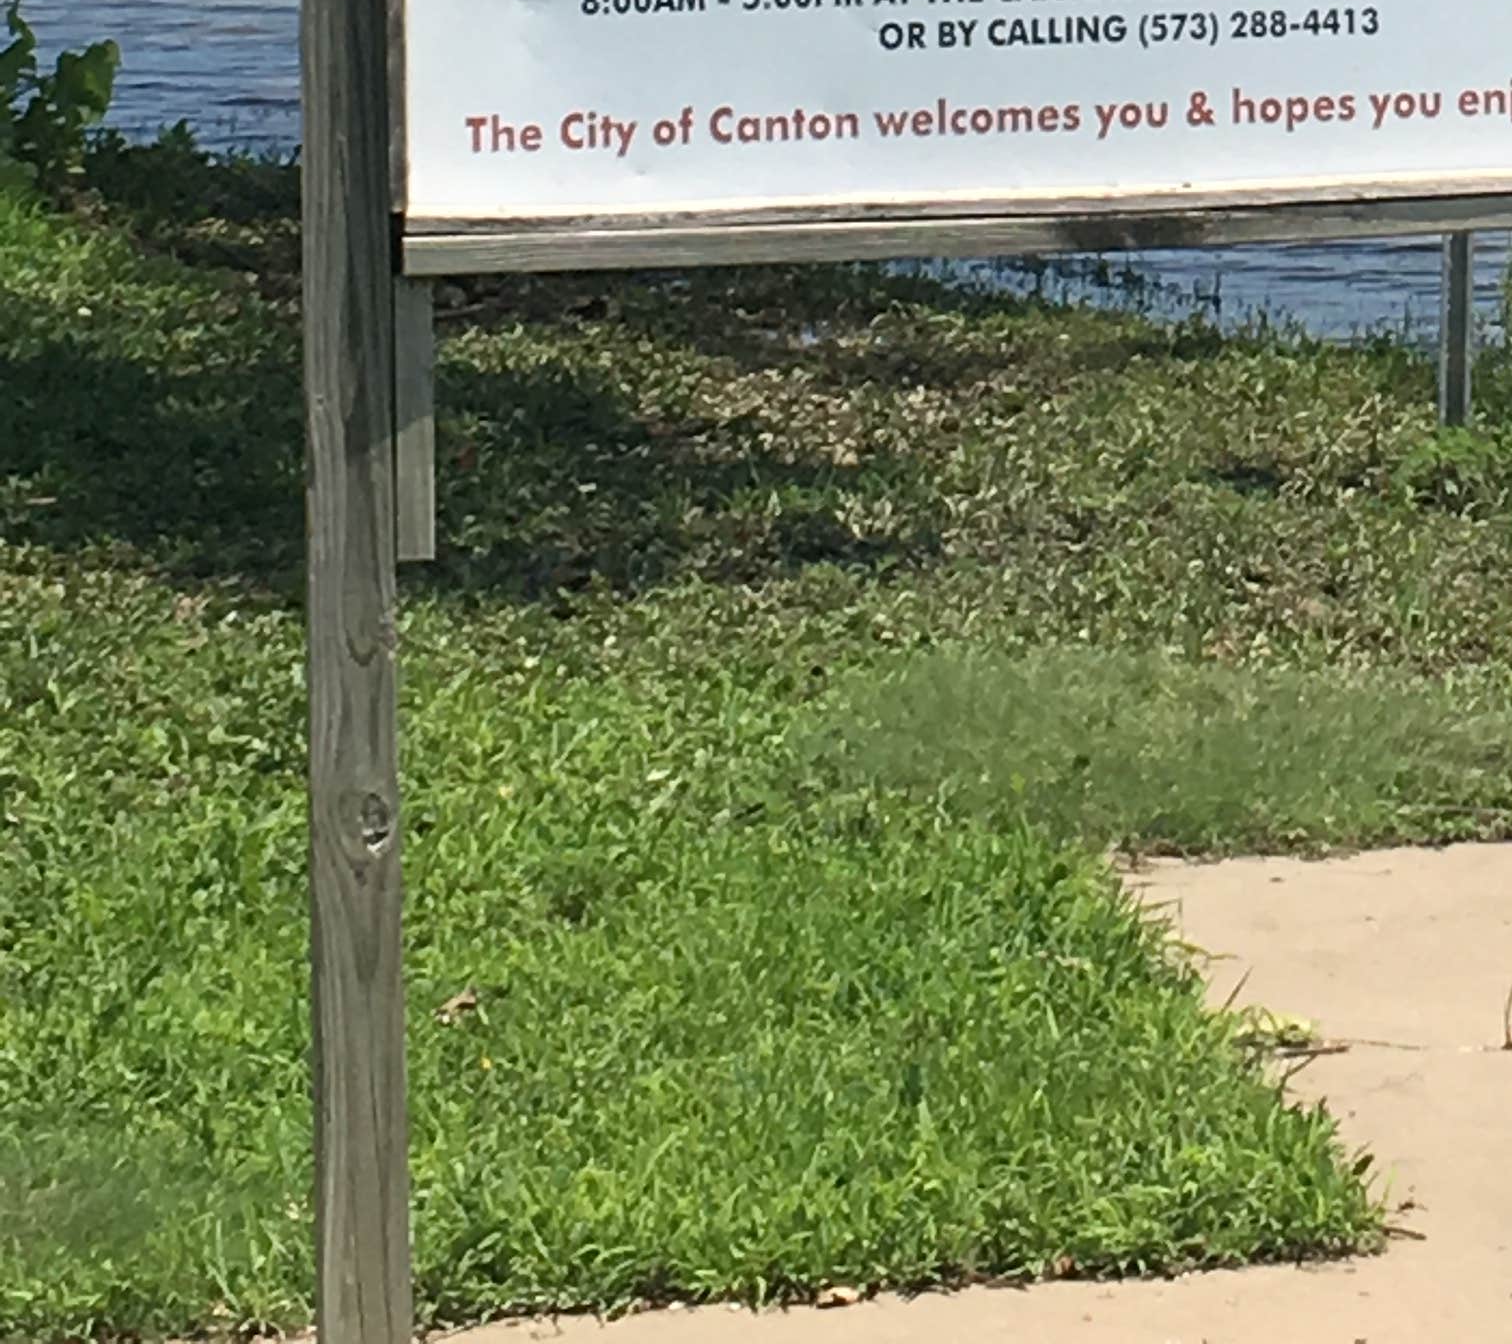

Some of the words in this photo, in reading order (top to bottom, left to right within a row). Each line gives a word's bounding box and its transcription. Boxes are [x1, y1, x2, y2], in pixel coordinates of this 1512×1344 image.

[879, 22, 926, 51] OR
[938, 19, 978, 48] BY
[987, 15, 1127, 47] CALLING
[1139, 12, 1219, 49] (573)
[1230, 7, 1379, 39] 288-4413
[465, 114, 543, 153] The
[560, 111, 637, 157] City
[653, 106, 693, 146] of
[709, 107, 859, 144] Canton
[873, 98, 1081, 137] welcomes
[1095, 102, 1168, 139] you
[1186, 91, 1215, 127] &
[1232, 87, 1356, 133] hopes
[1369, 92, 1441, 129] you
